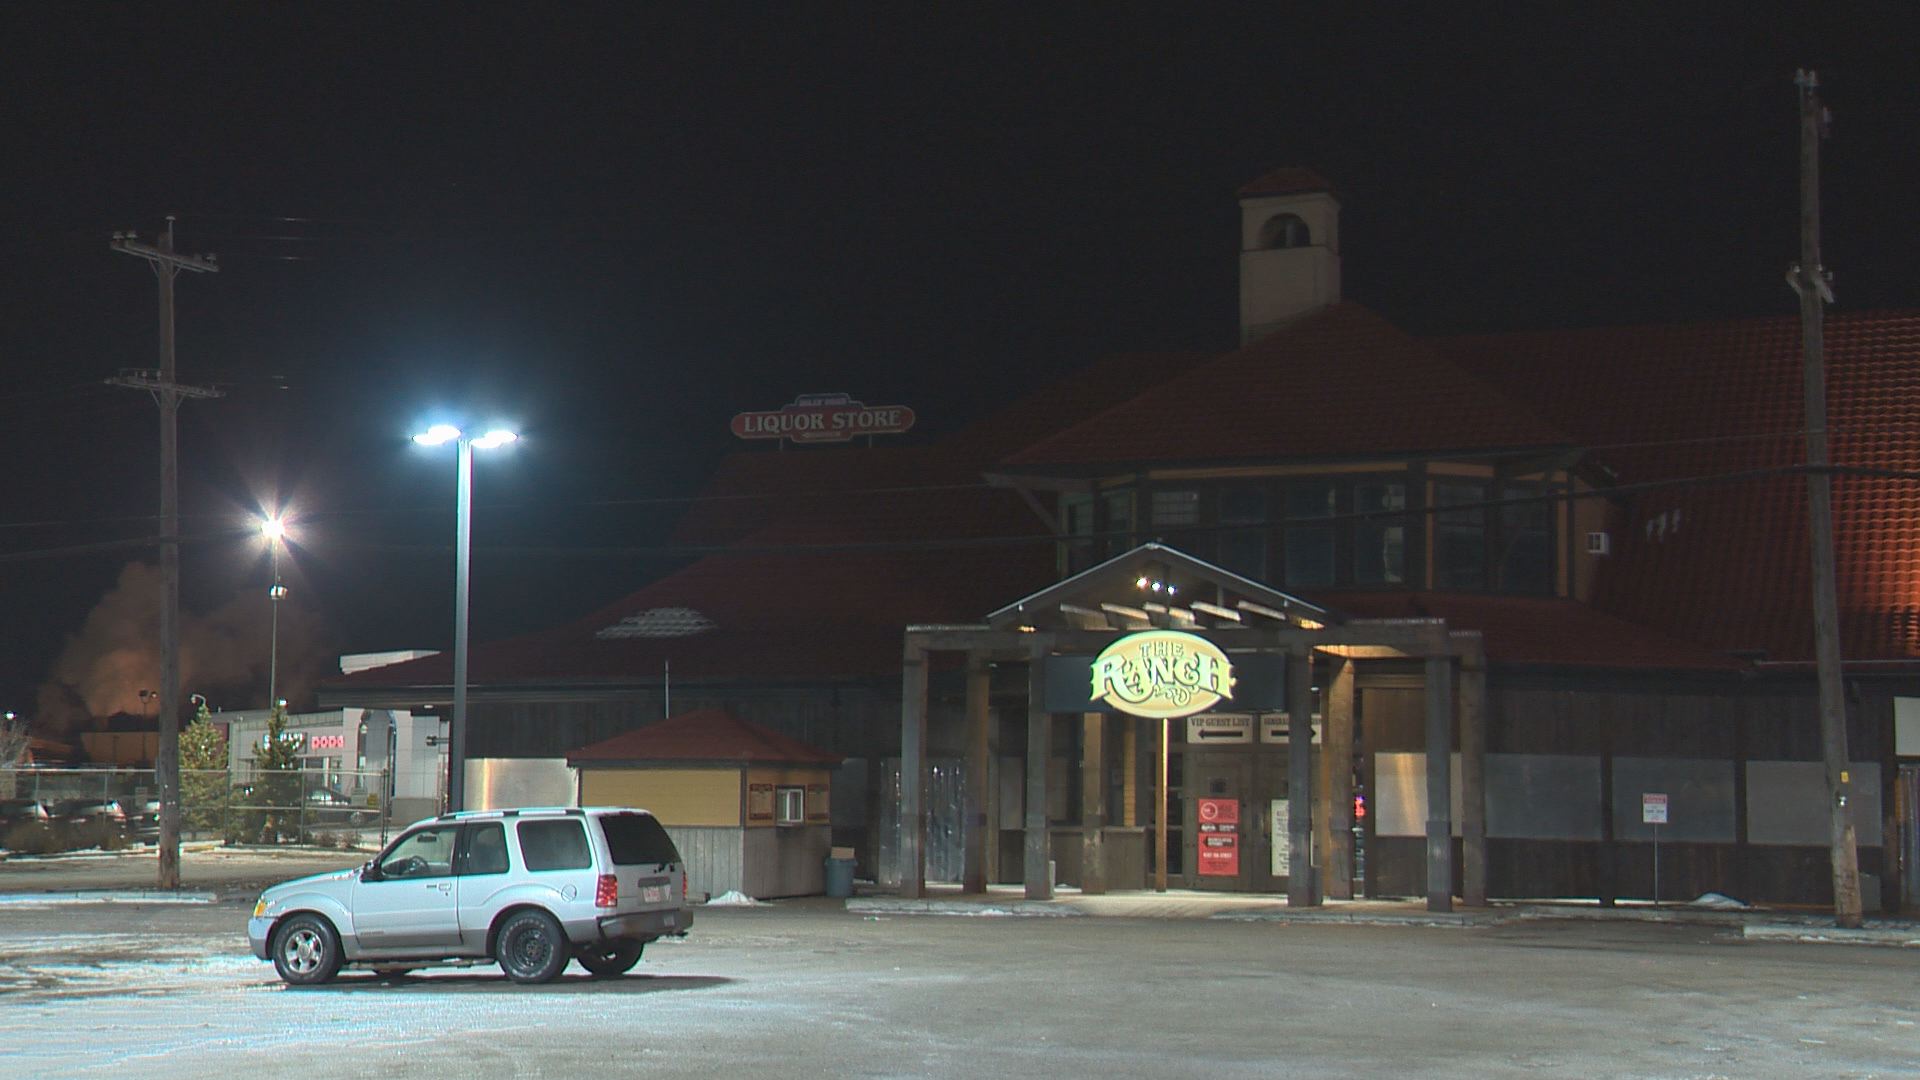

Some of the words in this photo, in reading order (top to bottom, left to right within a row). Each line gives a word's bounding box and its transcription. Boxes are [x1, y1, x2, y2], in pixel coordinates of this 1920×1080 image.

[744, 413, 825, 433] LIQUOR
[832, 409, 902, 429] STORE
[1139, 640, 1184, 657] THE
[1089, 651, 1234, 704] RANCH
[1190, 717, 1204, 727] VIP
[1205, 717, 1231, 727] GUEST
[1232, 717, 1250, 727] LIST
